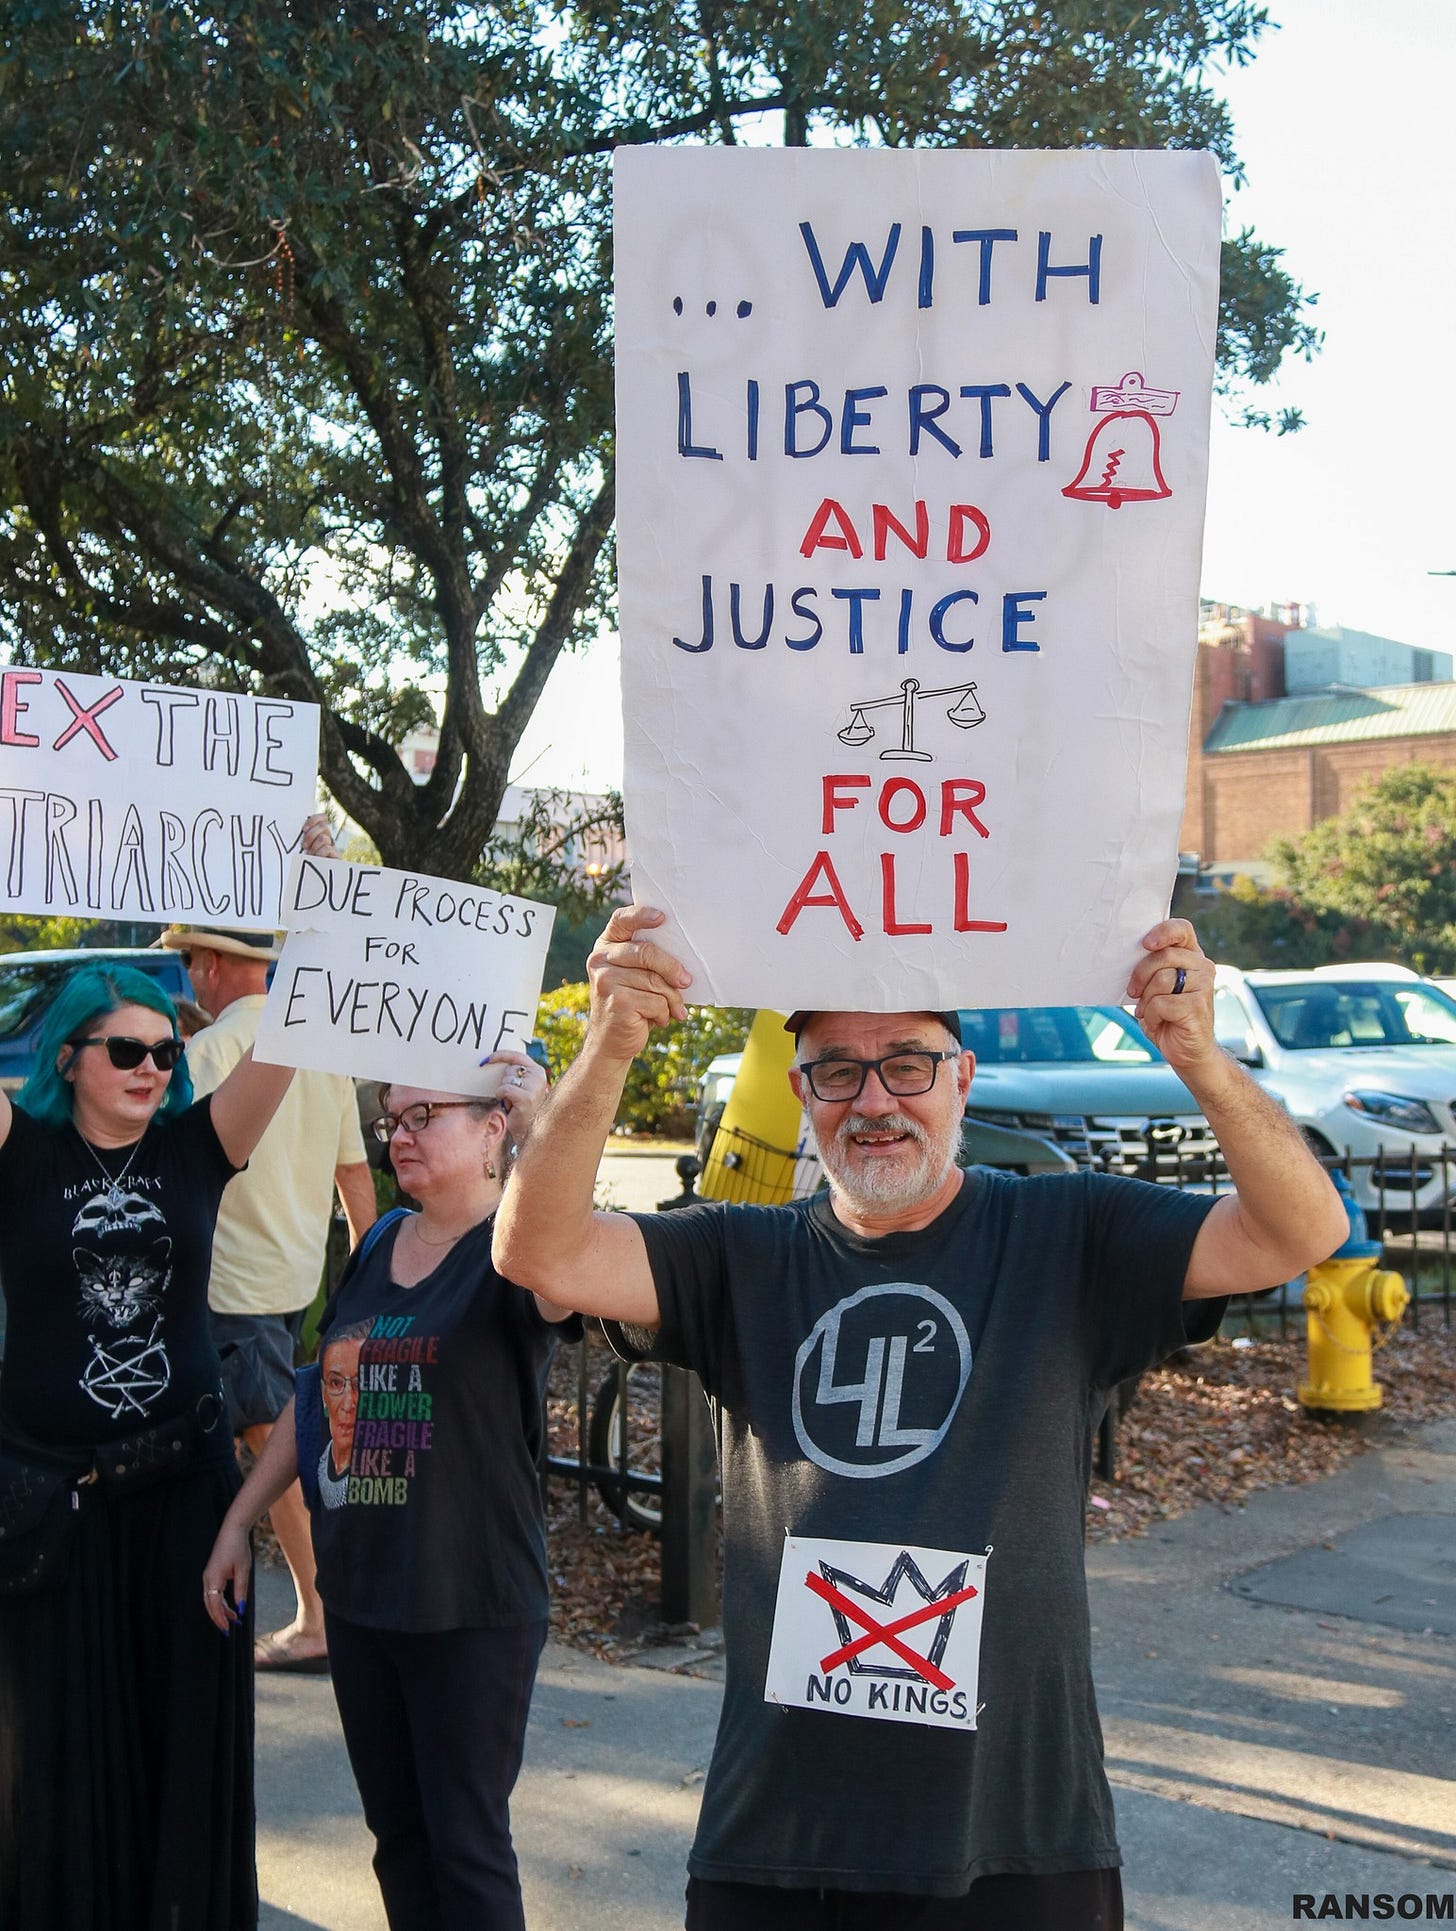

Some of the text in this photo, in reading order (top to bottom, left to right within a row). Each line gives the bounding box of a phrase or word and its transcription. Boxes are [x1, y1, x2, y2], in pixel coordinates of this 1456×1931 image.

[799, 222, 1102, 308] WITH
[678, 372, 1072, 462] LIBERTY
[800, 498, 990, 564] AND
[673, 574, 1047, 654] JUSTICE
[0, 672, 294, 786] EX THE
[822, 775, 989, 838] FOR
[294, 860, 536, 938] DUE PROCESS
[775, 851, 1008, 941] ALL
[365, 936, 420, 965] FOR
[361, 1336, 440, 1364] FRAGILE
[370, 1315, 415, 1338] NOT
[359, 1364, 422, 1392] LIKE A
[358, 1392, 433, 1421] FLOWER
[353, 1421, 434, 1449] FRAGILE
[351, 1449, 415, 1478] LIKE A
[348, 1477, 408, 1505] BOMB
[806, 1673, 967, 1720] NO KINGS
